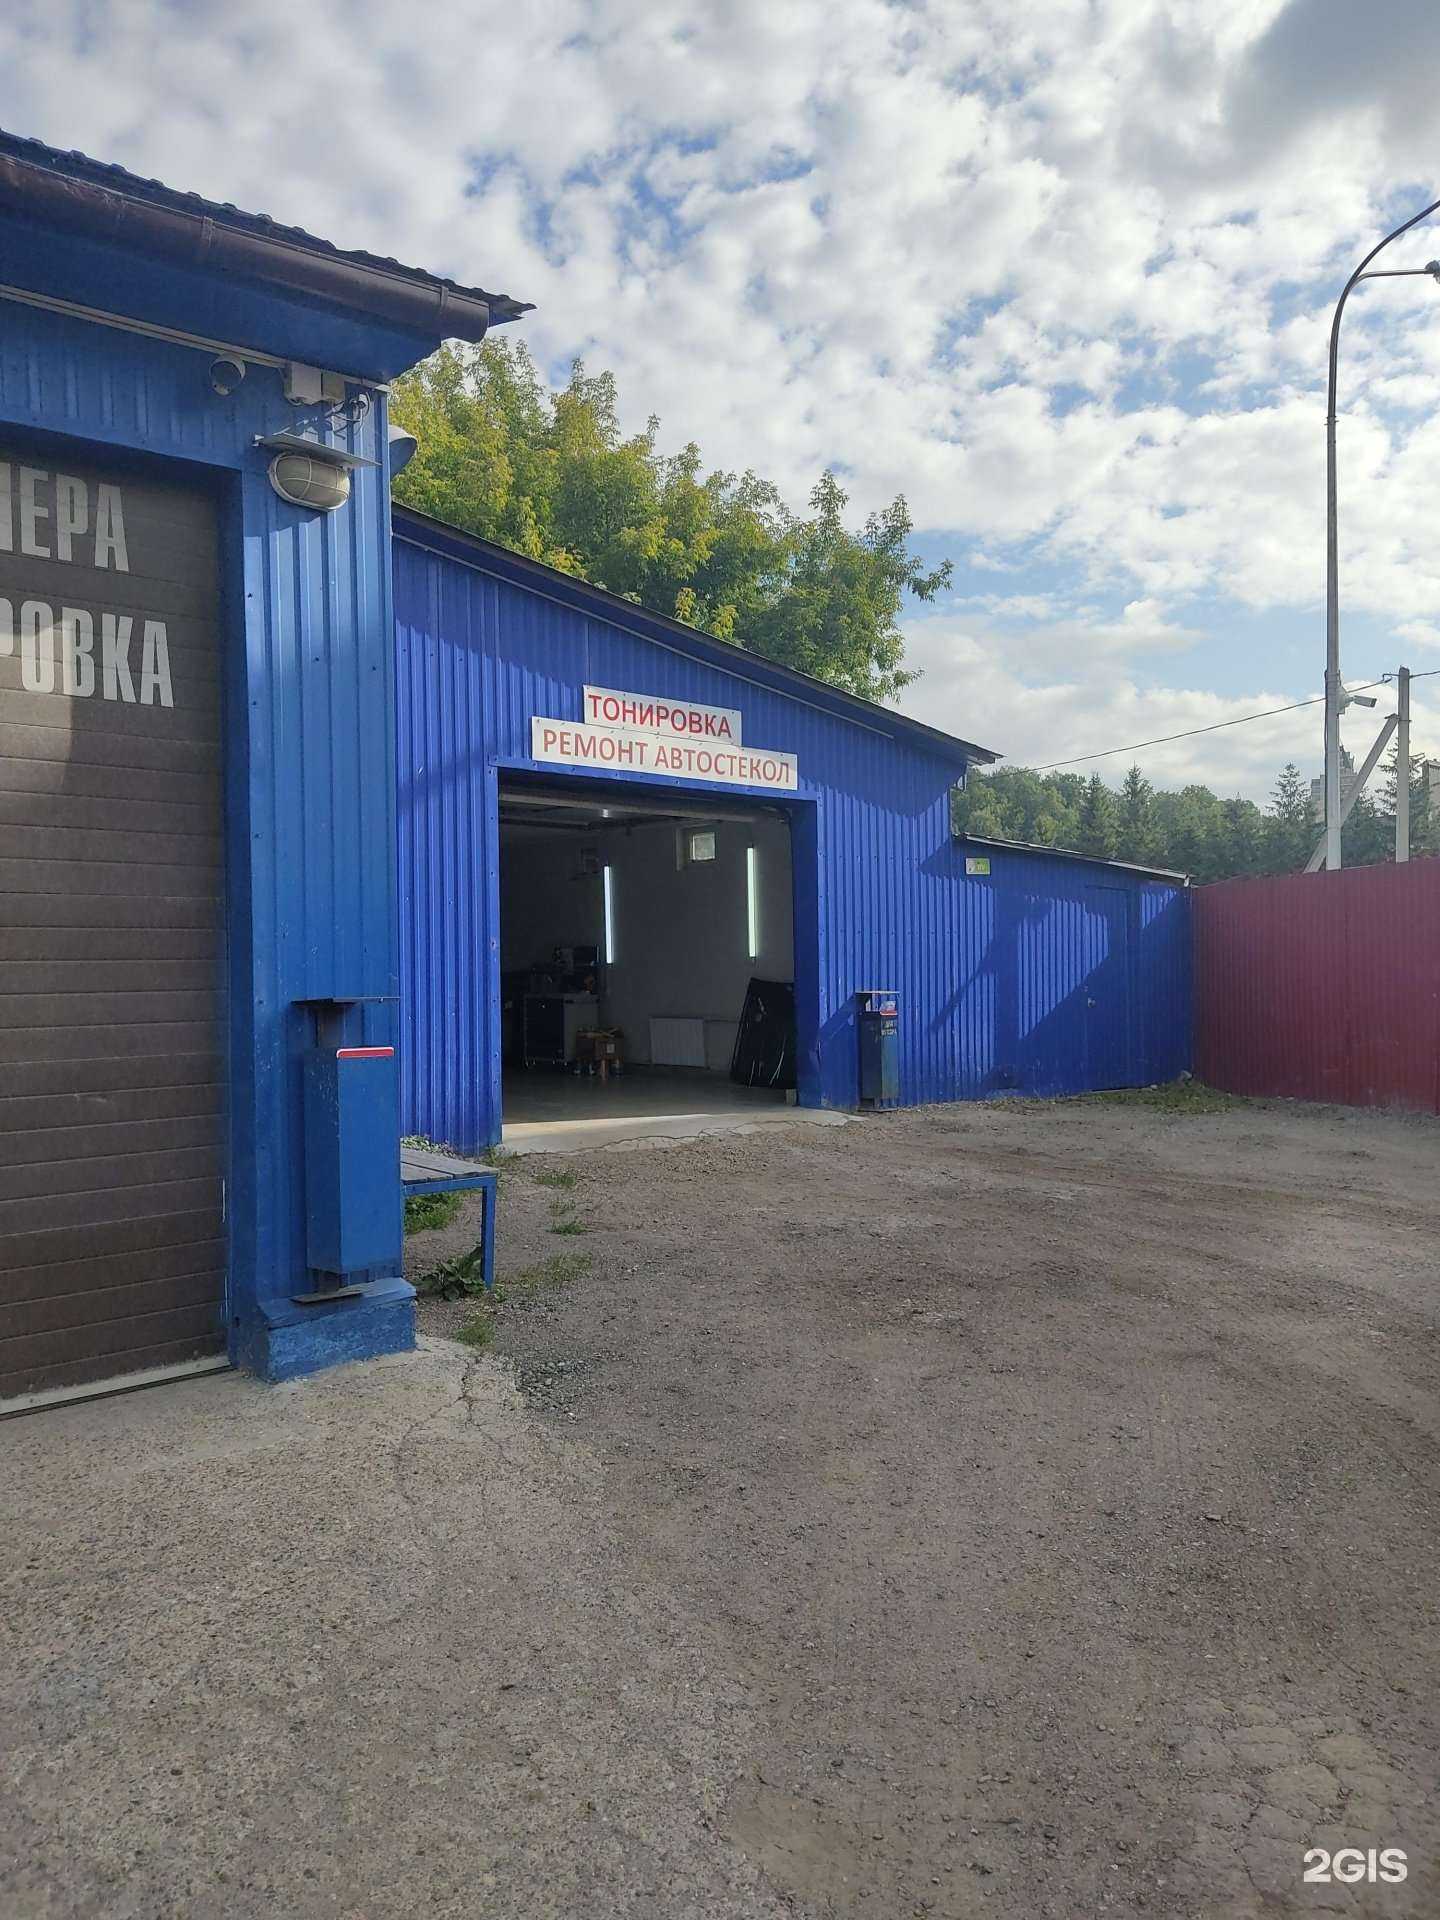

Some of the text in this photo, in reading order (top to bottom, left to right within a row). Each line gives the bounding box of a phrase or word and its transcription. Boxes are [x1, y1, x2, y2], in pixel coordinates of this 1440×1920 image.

[588, 694, 732, 738] ТОНИРОВКА
[543, 728, 790, 783] РЕМОНТ АВТОСТЕКОЛ
